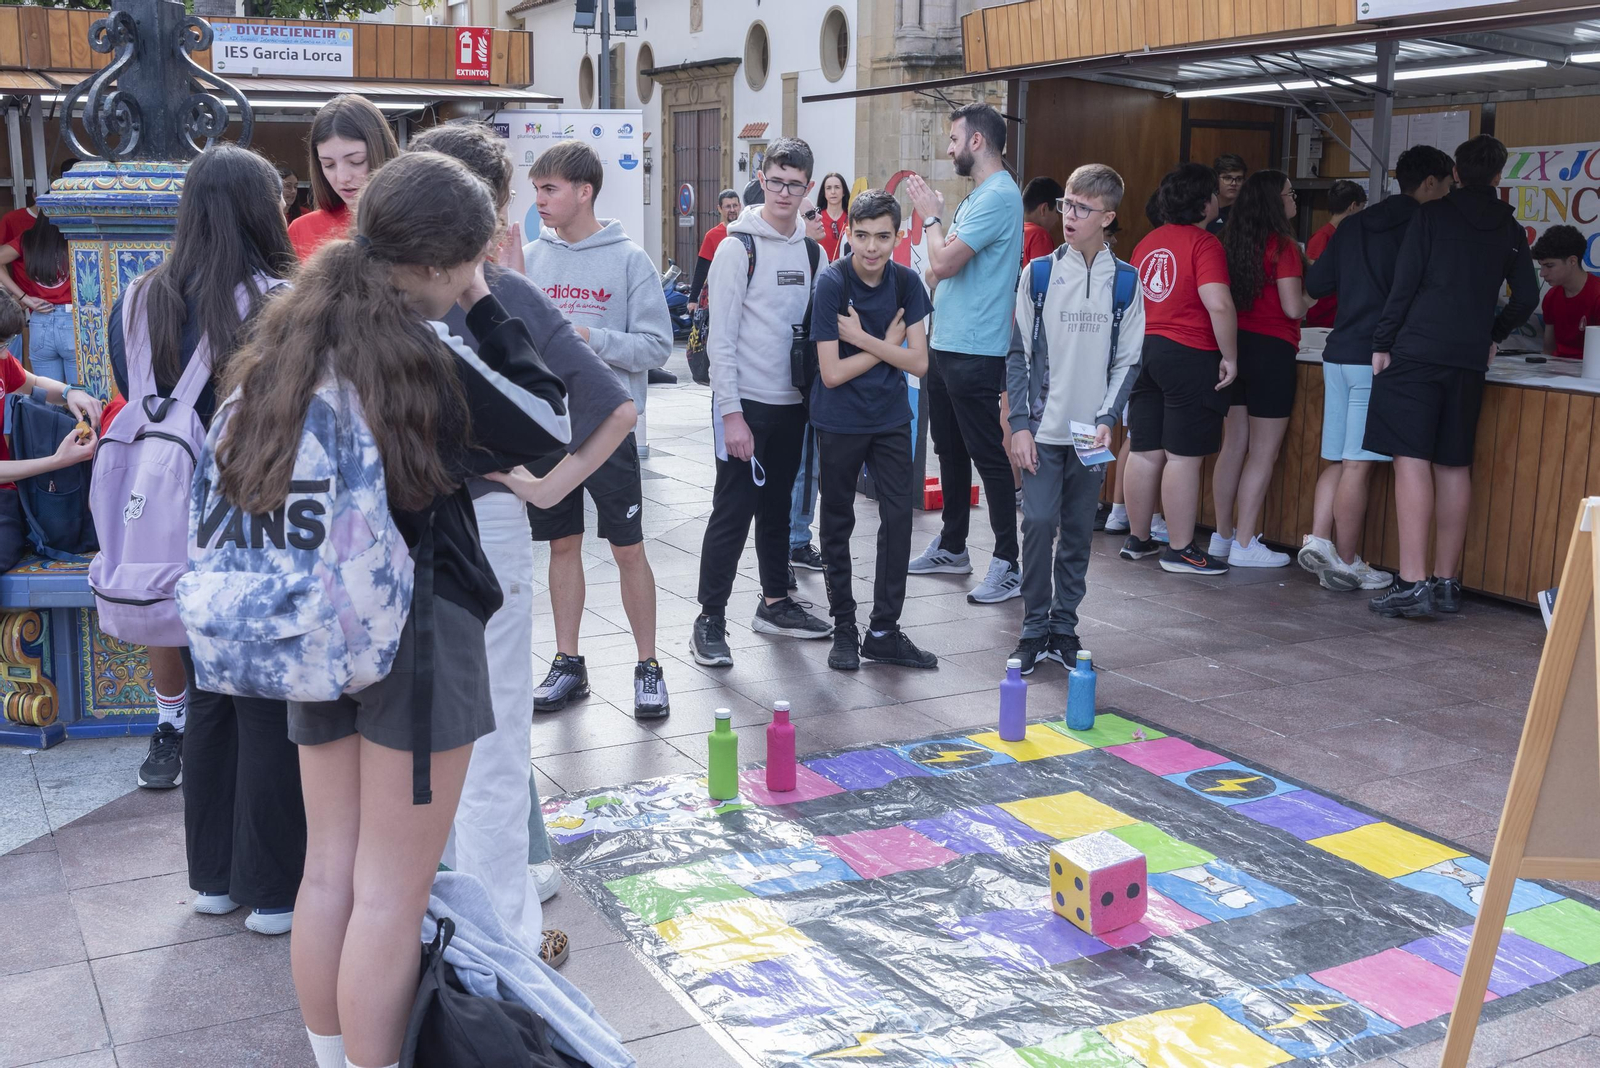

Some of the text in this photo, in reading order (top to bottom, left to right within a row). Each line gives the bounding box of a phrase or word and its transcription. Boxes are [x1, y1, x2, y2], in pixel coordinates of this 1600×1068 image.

[236, 25, 336, 39] DIVERCIENCIA
[224, 45, 342, 62] IES Garcia Lorca
[456, 69, 489, 77] EXTINTOR
[542, 284, 590, 300] didas
[1059, 310, 1109, 323] Emirates
[1067, 322, 1101, 333] FLY BETTER
[197, 478, 331, 551] VANS
